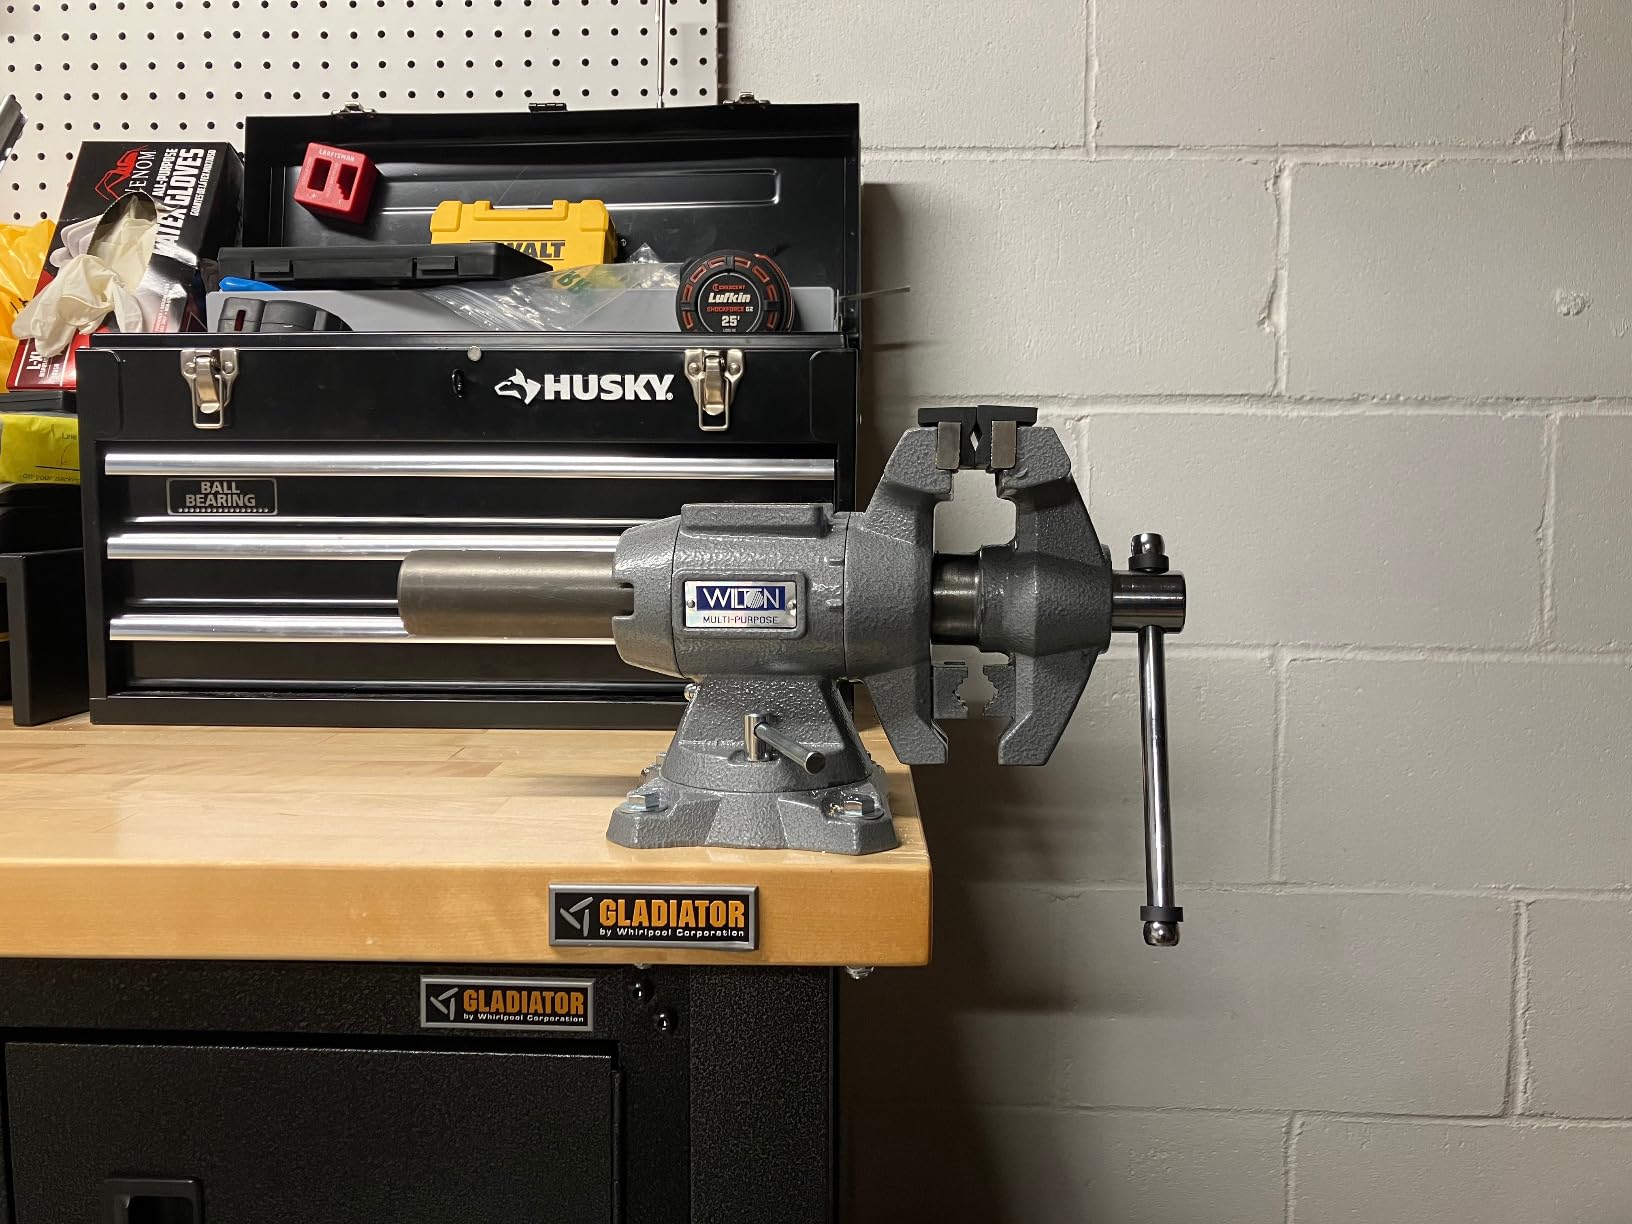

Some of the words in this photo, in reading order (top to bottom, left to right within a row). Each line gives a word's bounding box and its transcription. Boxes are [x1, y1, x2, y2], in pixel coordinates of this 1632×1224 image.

[152, 148, 178, 196] ALL-PURPOSE
[163, 148, 205, 206] GLOVES
[708, 292, 751, 303] Lufkin
[721, 315, 740, 327] 25'
[200, 481, 240, 494] BALL
[185, 494, 256, 507] BEARING
[702, 587, 780, 609] WILTON
[703, 615, 781, 625] MULTI-PURPOSE
[600, 898, 745, 928] GLADIATOR
[599, 928, 612, 938] by
[617, 928, 671, 938] Whirlpool
[676, 929, 744, 939] Corporation
[463, 989, 584, 1015] GLADIATOR
[463, 1013, 474, 1021] by
[477, 1013, 523, 1022] Whirlpool
[527, 1014, 584, 1023] Corporation
